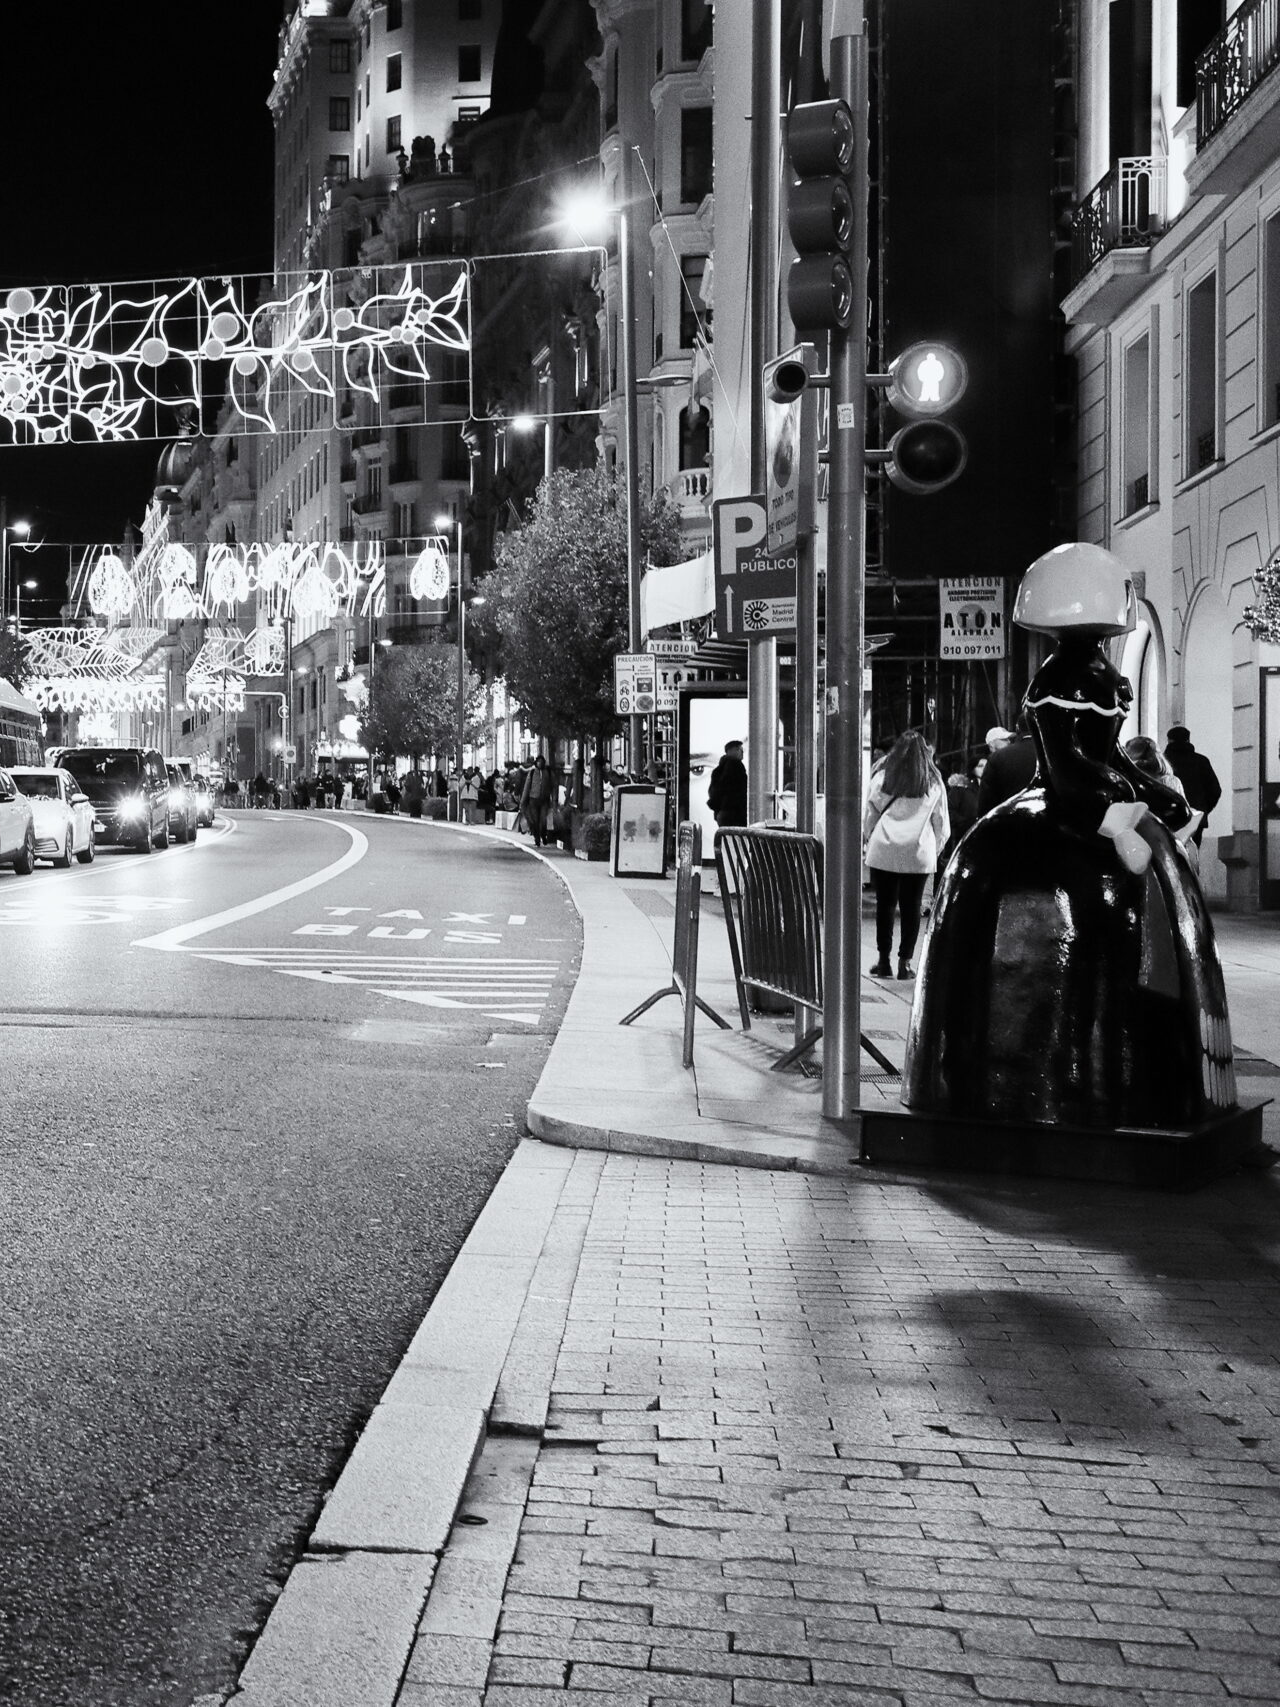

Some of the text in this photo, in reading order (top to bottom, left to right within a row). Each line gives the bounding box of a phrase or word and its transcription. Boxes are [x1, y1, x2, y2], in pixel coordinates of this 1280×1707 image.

[718, 501, 768, 575] P
[740, 558, 796, 573] PÚBLICO
[951, 628, 995, 636] ALARMAS
[943, 645, 1001, 655] 910 097 011
[323, 906, 527, 926] TAXI
[291, 923, 502, 945] BUS
